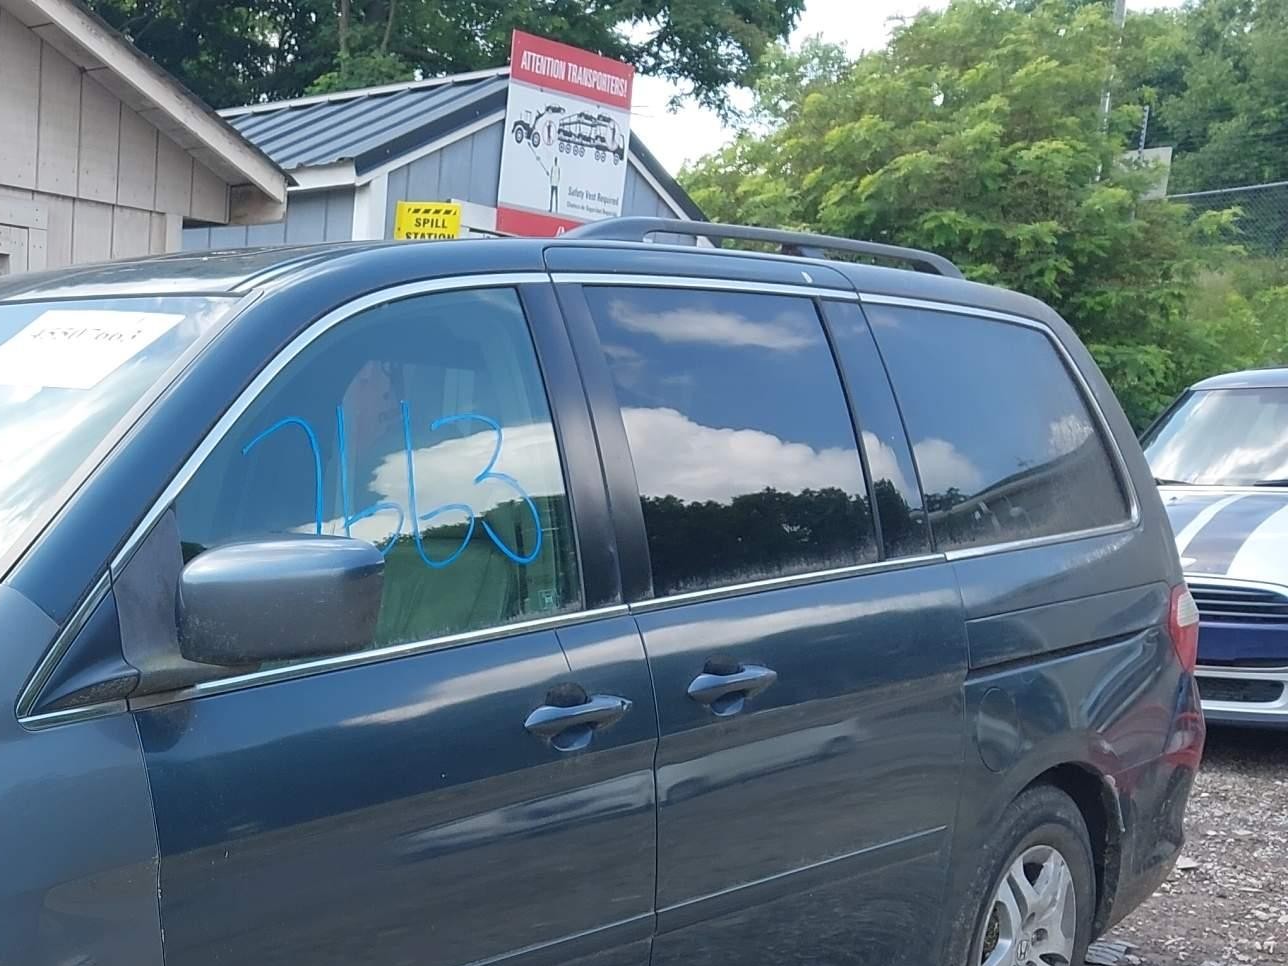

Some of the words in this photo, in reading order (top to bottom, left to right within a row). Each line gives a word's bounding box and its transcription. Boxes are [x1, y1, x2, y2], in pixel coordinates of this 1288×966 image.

[520, 50, 566, 81] ATTENTION
[567, 62, 628, 98] TRANSPORTERS!
[414, 217, 448, 229] SPILL
